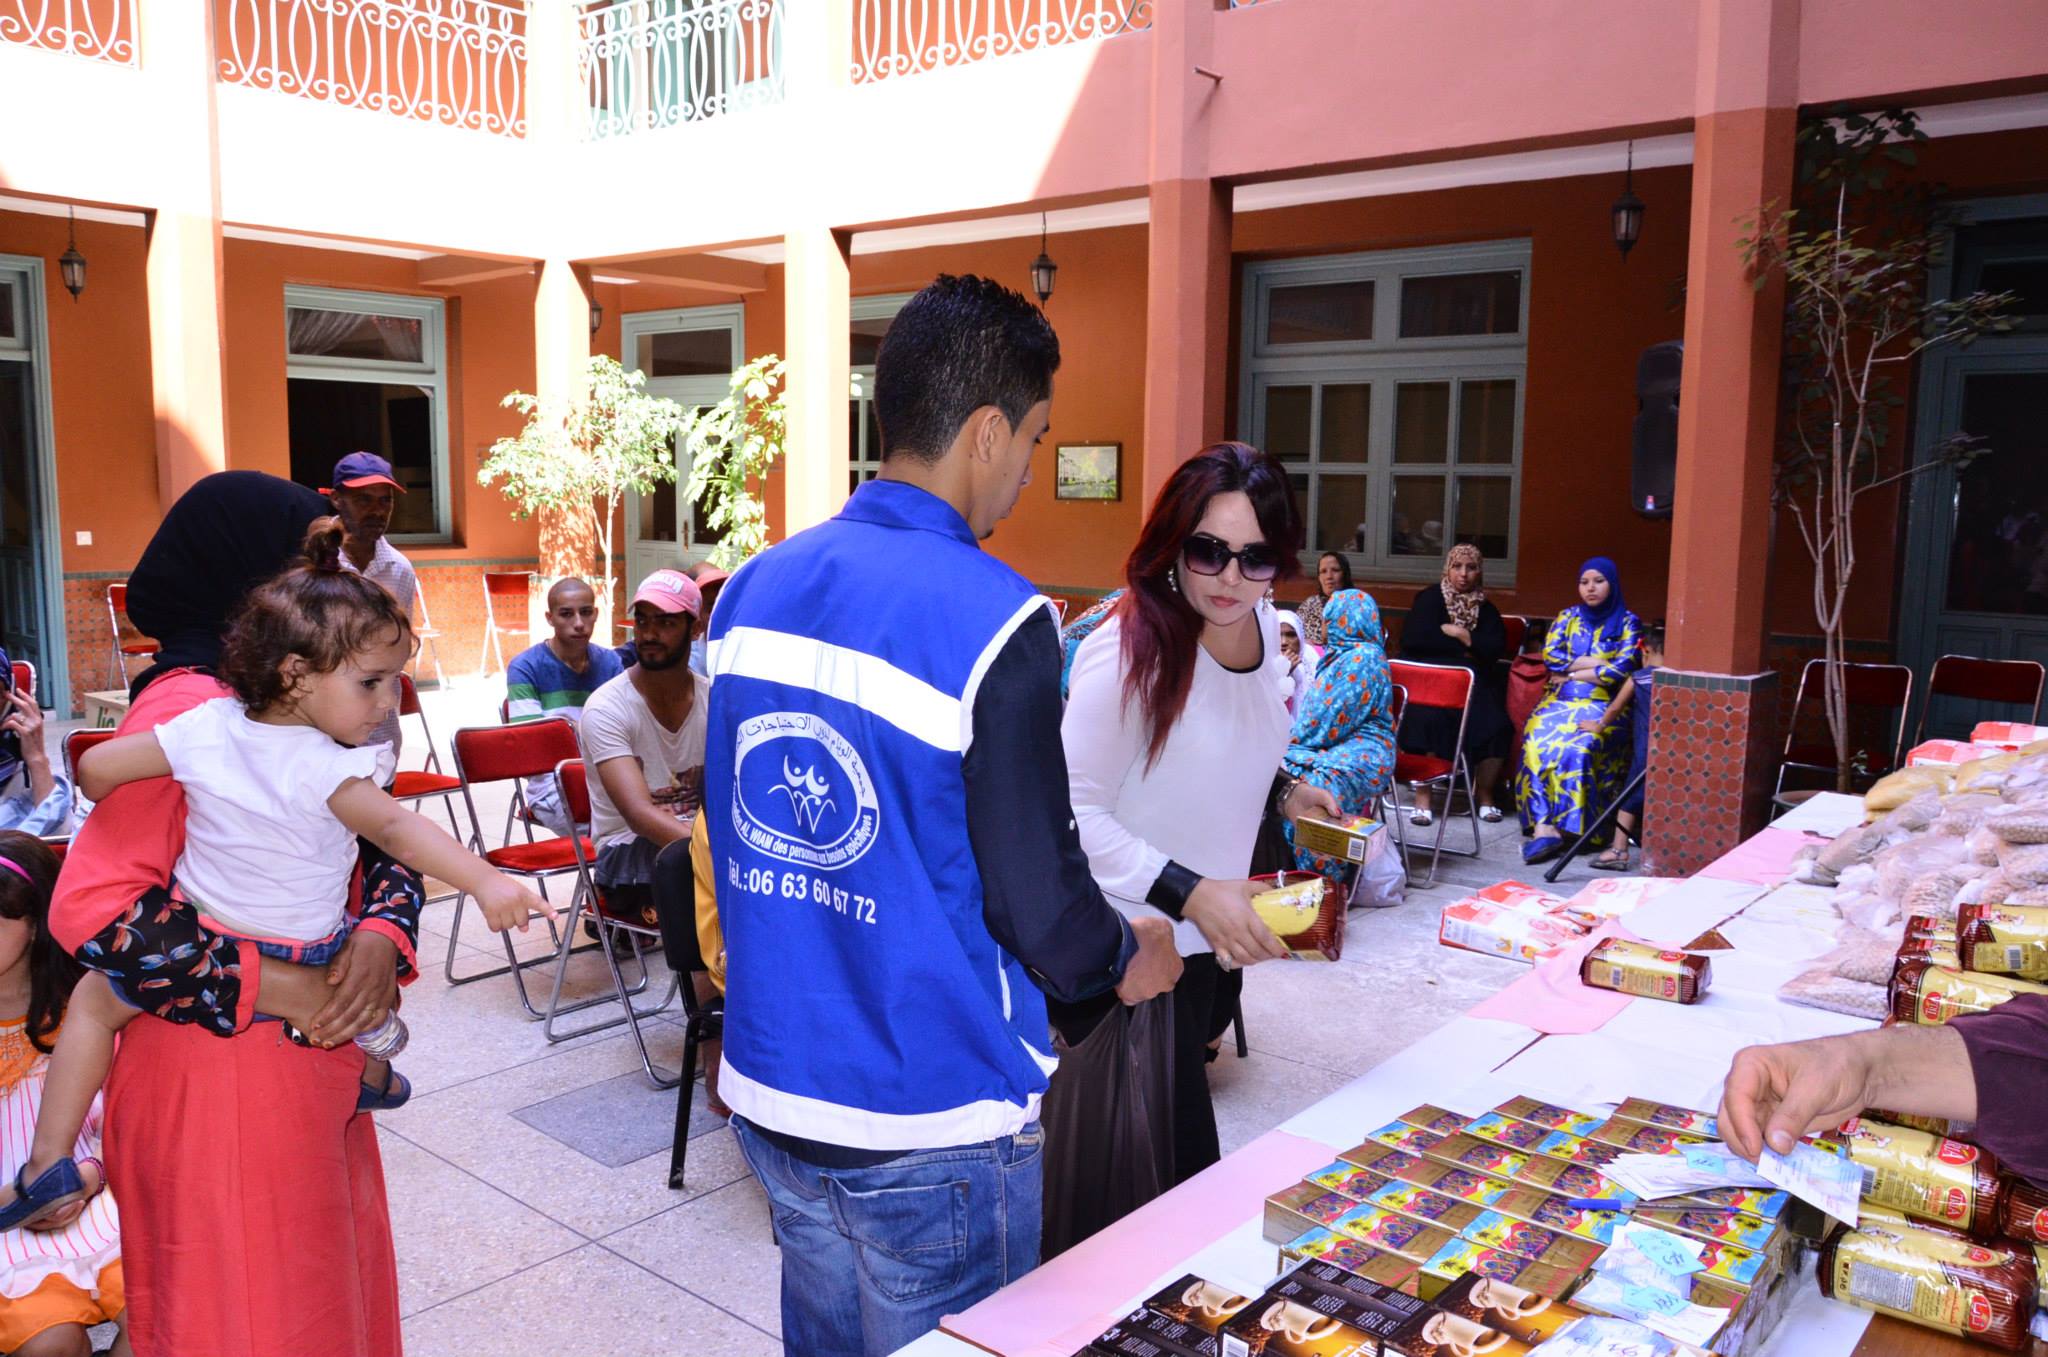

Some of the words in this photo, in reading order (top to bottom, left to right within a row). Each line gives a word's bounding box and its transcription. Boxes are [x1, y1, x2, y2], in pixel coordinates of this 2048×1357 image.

[749, 827, 774, 850] WIAM
[772, 838, 788, 856] des
[781, 872, 807, 900] 63
[813, 878, 831, 907] 60
[833, 887, 849, 915] 67
[853, 895, 877, 925] 72
